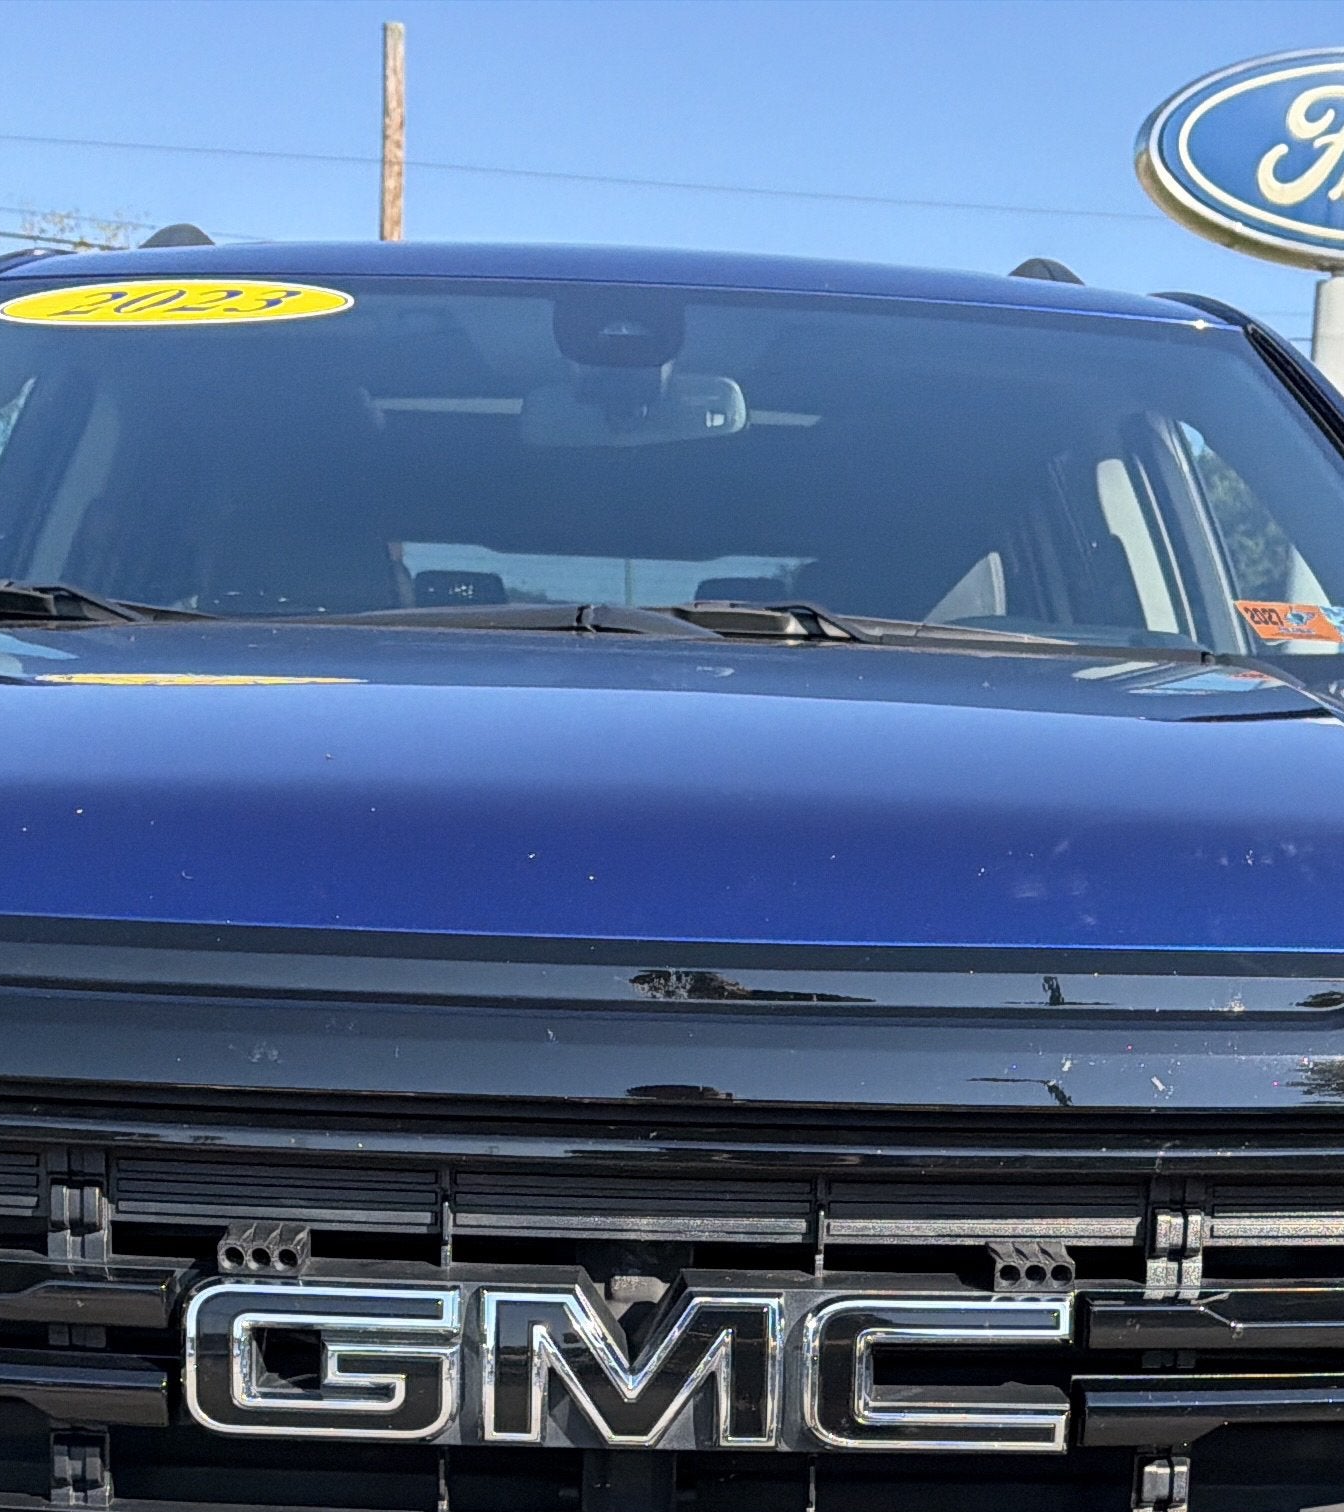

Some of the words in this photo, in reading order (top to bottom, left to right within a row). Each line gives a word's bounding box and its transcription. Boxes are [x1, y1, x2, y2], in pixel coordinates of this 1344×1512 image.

[46, 289, 303, 318] 2023
[1243, 607, 1284, 627] 2027
[182, 1281, 1076, 1455] GMC
